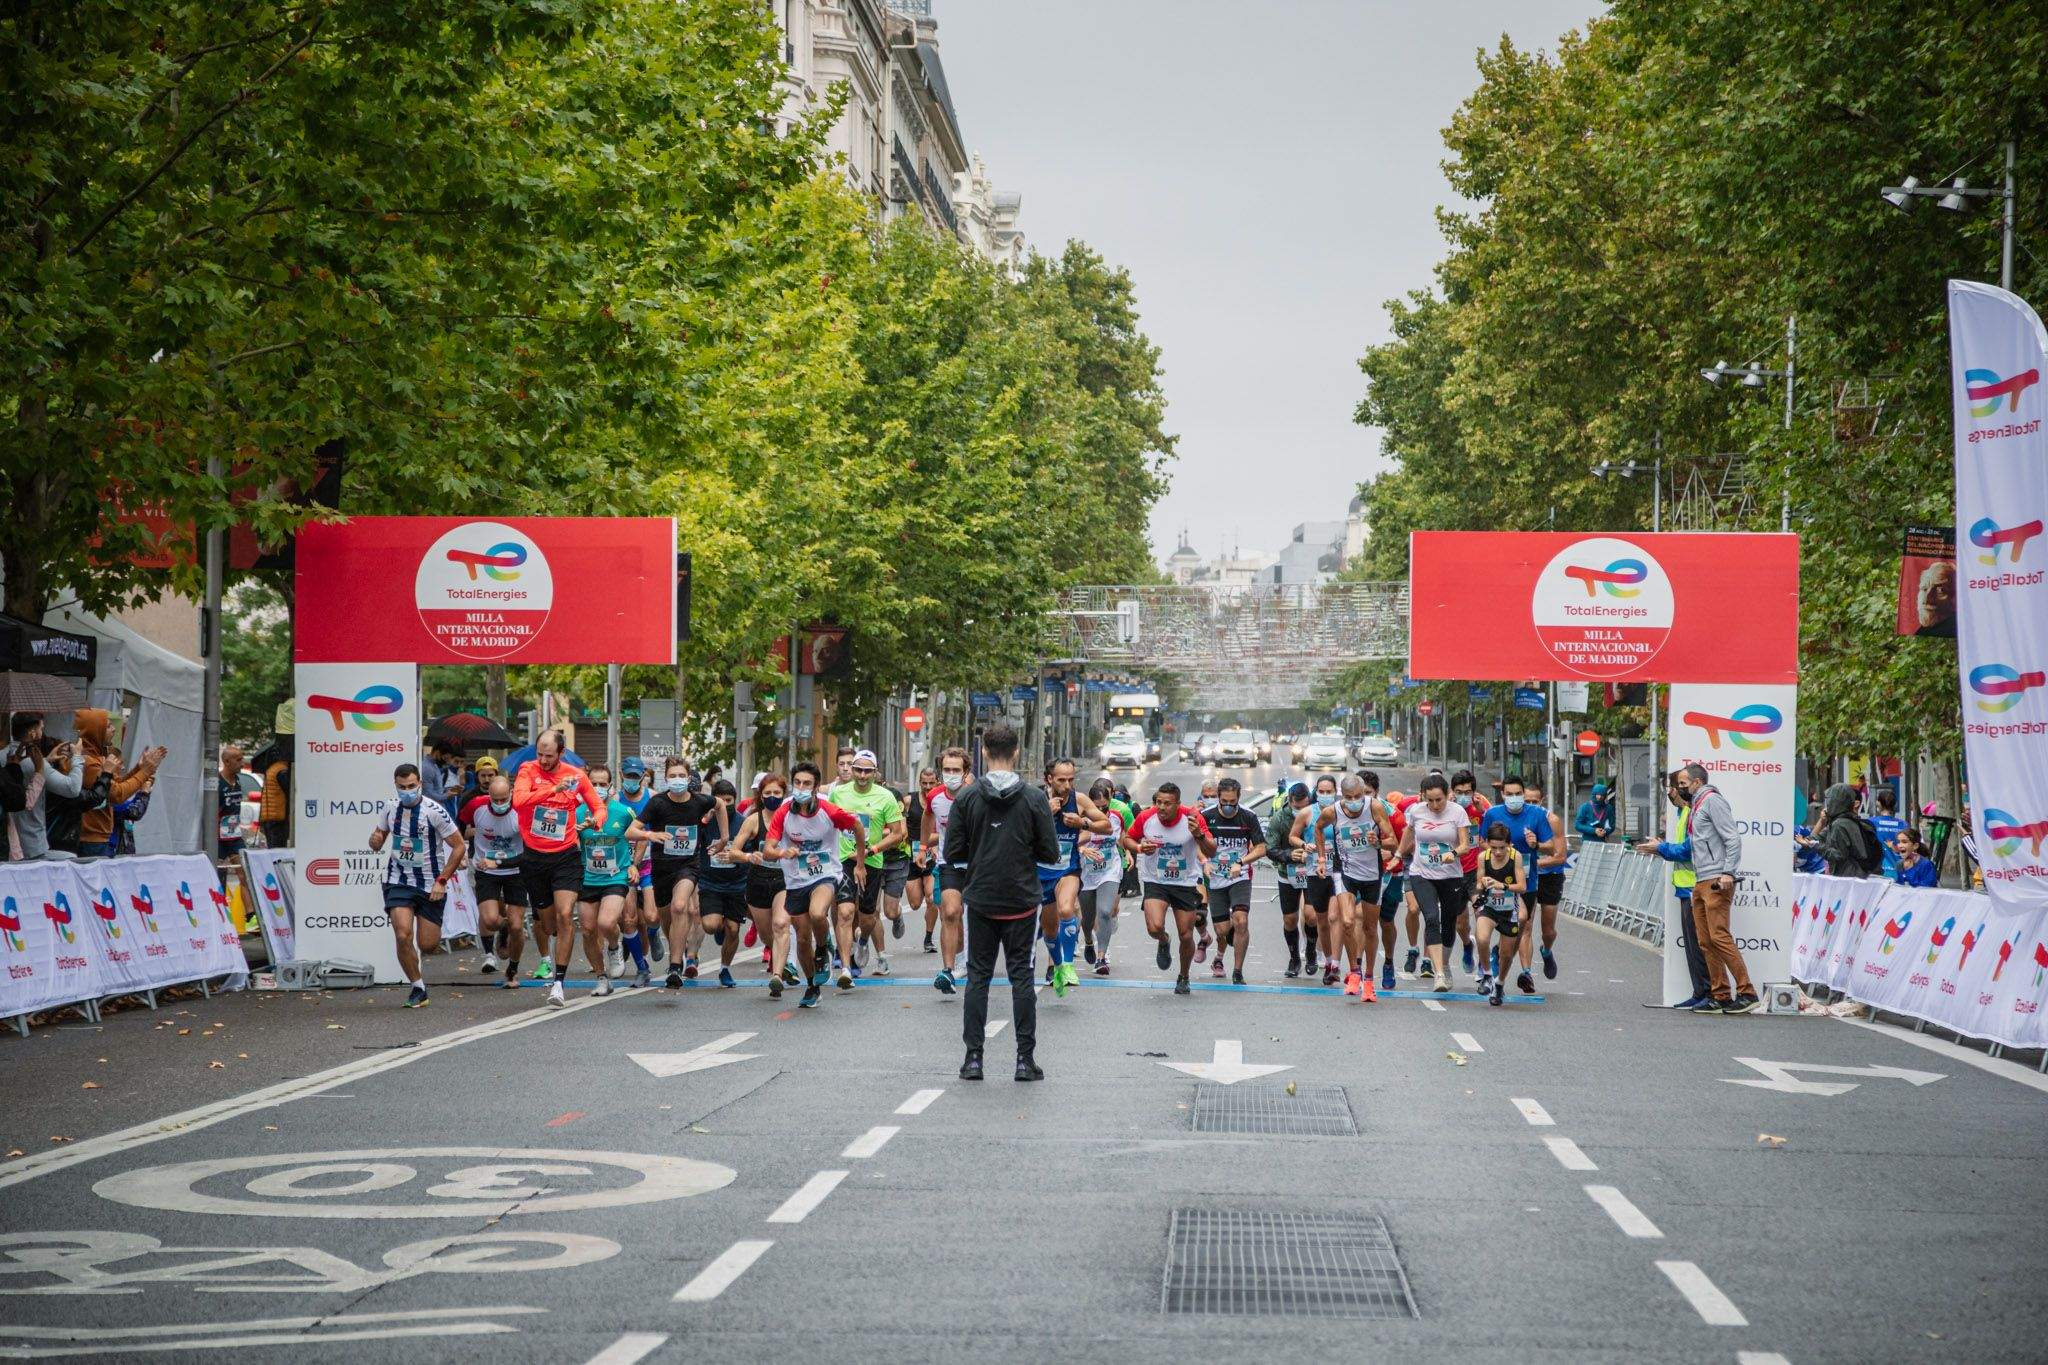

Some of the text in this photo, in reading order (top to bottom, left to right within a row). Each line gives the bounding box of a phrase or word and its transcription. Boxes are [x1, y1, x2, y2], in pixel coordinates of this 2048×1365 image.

[446, 588, 528, 602] TotalEnergies
[1563, 605, 1648, 619] TotalEnergies
[465, 613, 504, 623] MILLA
[1583, 630, 1623, 640] MILLA
[451, 636, 519, 647] DE MADRID
[1569, 654, 1638, 664] DE MADRID
[307, 741, 404, 755] TotalEnergies
[1682, 759, 1783, 775] TtalEnergies
[330, 800, 385, 815] MADR
[540, 823, 557, 834] 313
[1736, 821, 1785, 836] DRID
[673, 839, 690, 850] 352
[1351, 837, 1367, 848] 326
[399, 851, 415, 862] 242
[1428, 854, 1443, 864] 361
[345, 858, 386, 871] MILL
[592, 859, 608, 869] 444
[808, 865, 824, 876] 342
[1163, 870, 1180, 879] 349
[343, 873, 383, 886] URBA
[1738, 880, 1774, 892] LLA
[1733, 895, 1780, 908] RBANA
[304, 916, 392, 929] CORREDOR
